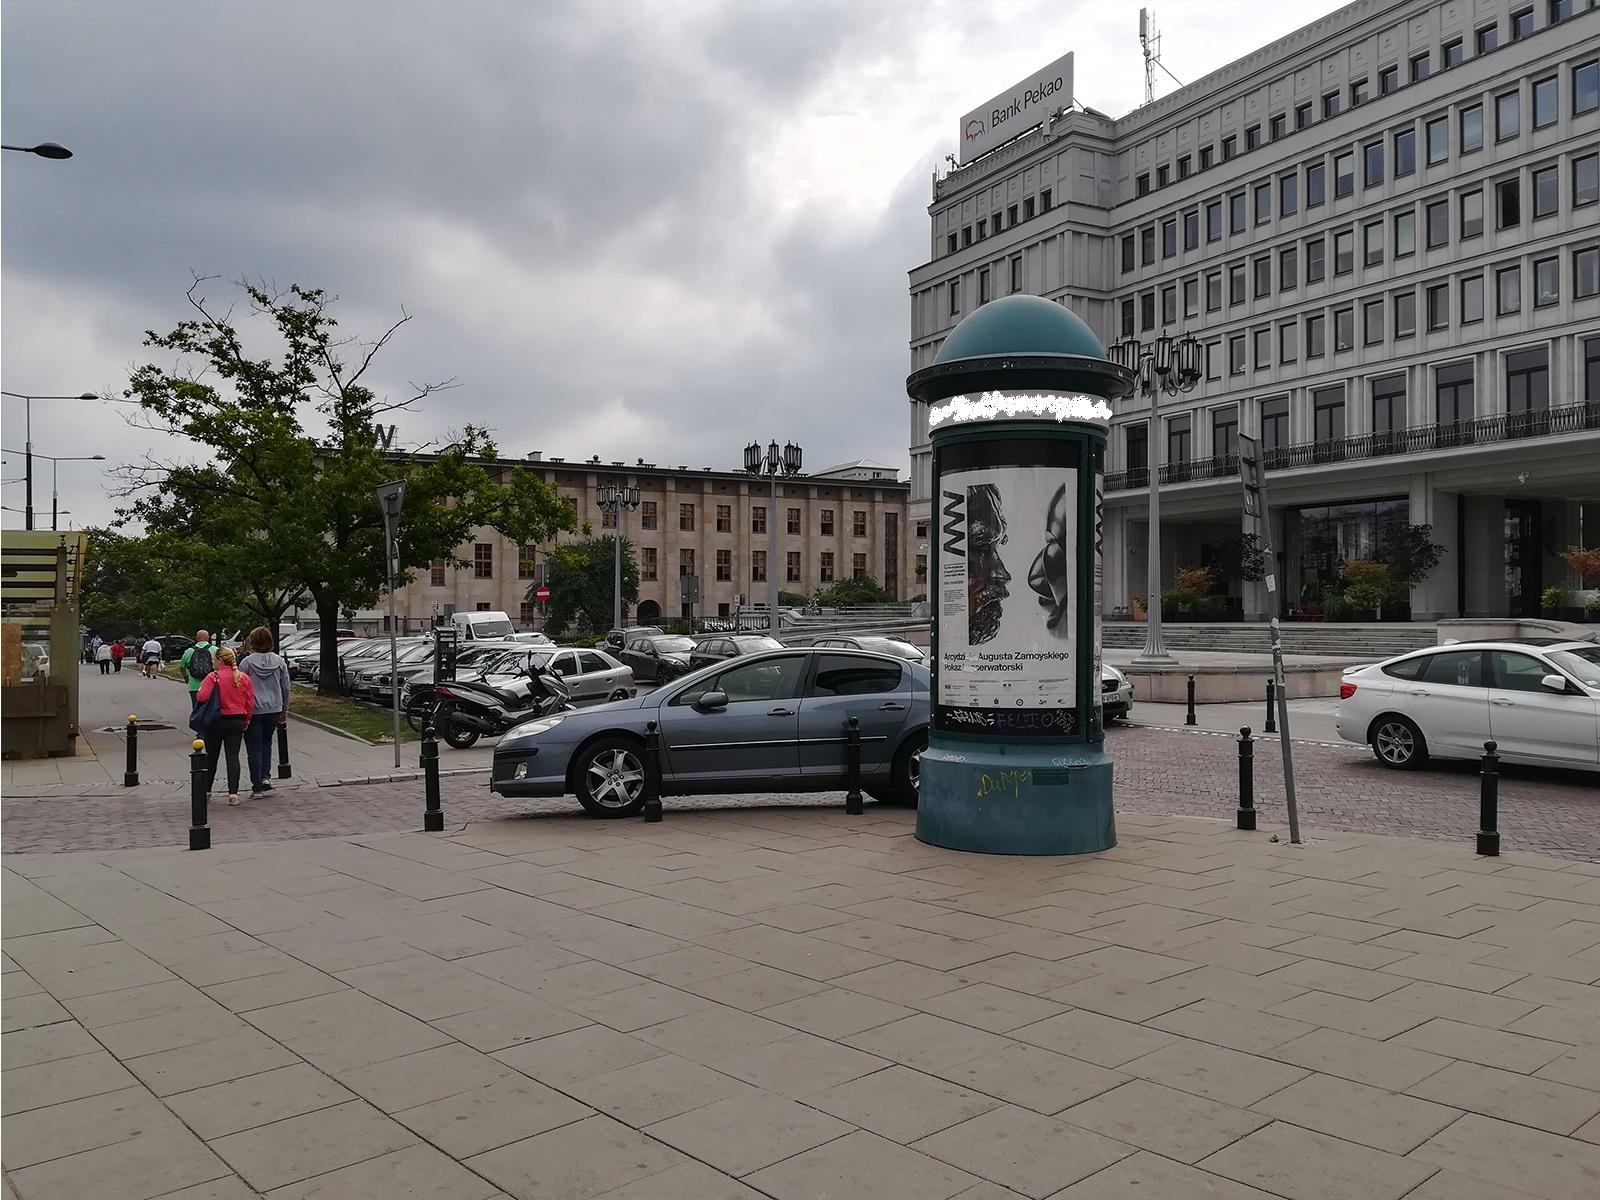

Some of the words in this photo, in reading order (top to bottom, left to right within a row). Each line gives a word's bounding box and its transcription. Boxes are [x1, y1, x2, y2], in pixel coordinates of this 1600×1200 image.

[991, 98, 1021, 128] Bank
[1024, 77, 1063, 110] Pekao
[978, 652, 1013, 662] Augusta
[1014, 651, 1069, 662] Zamoyskiego
